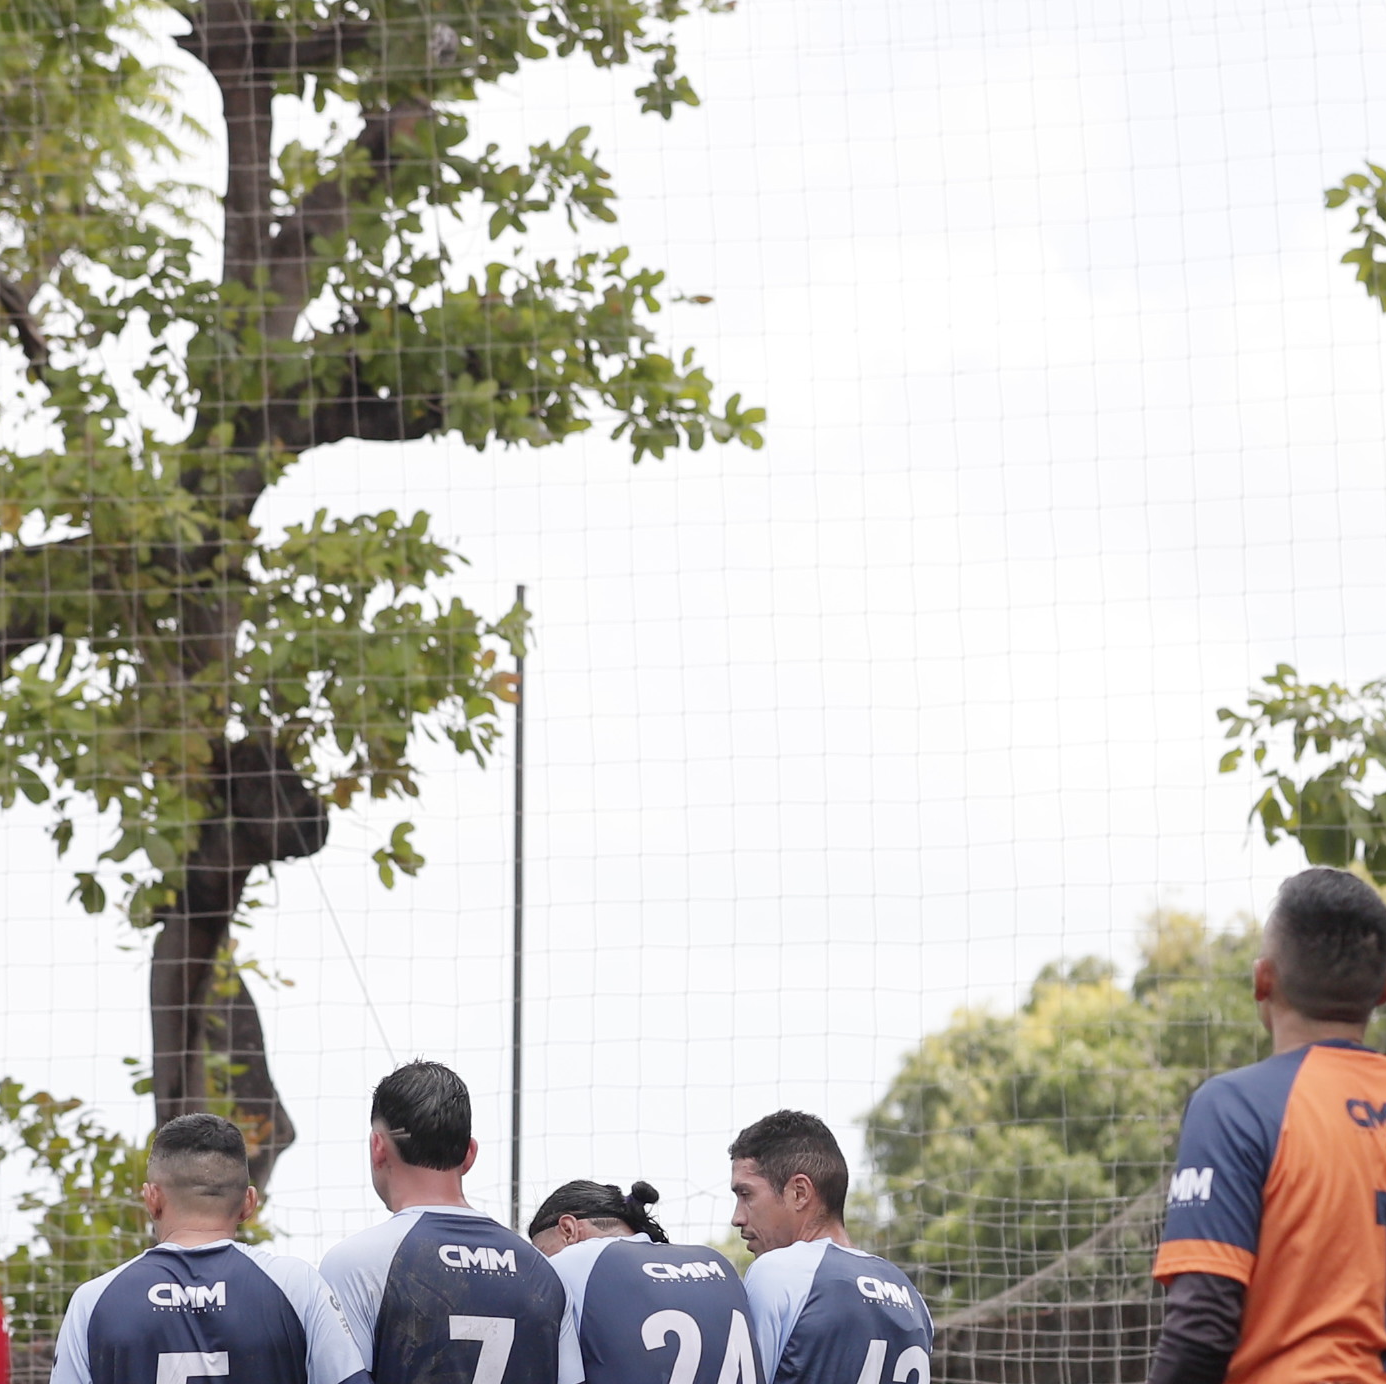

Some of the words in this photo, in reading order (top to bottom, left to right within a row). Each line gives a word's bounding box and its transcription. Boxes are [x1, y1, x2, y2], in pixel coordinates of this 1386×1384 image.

[1166, 1167, 1214, 1204] MM
[438, 1244, 517, 1272] CMM
[642, 1261, 726, 1280] CMM
[147, 1281, 226, 1309] CMM
[856, 1275, 914, 1308] CMM
